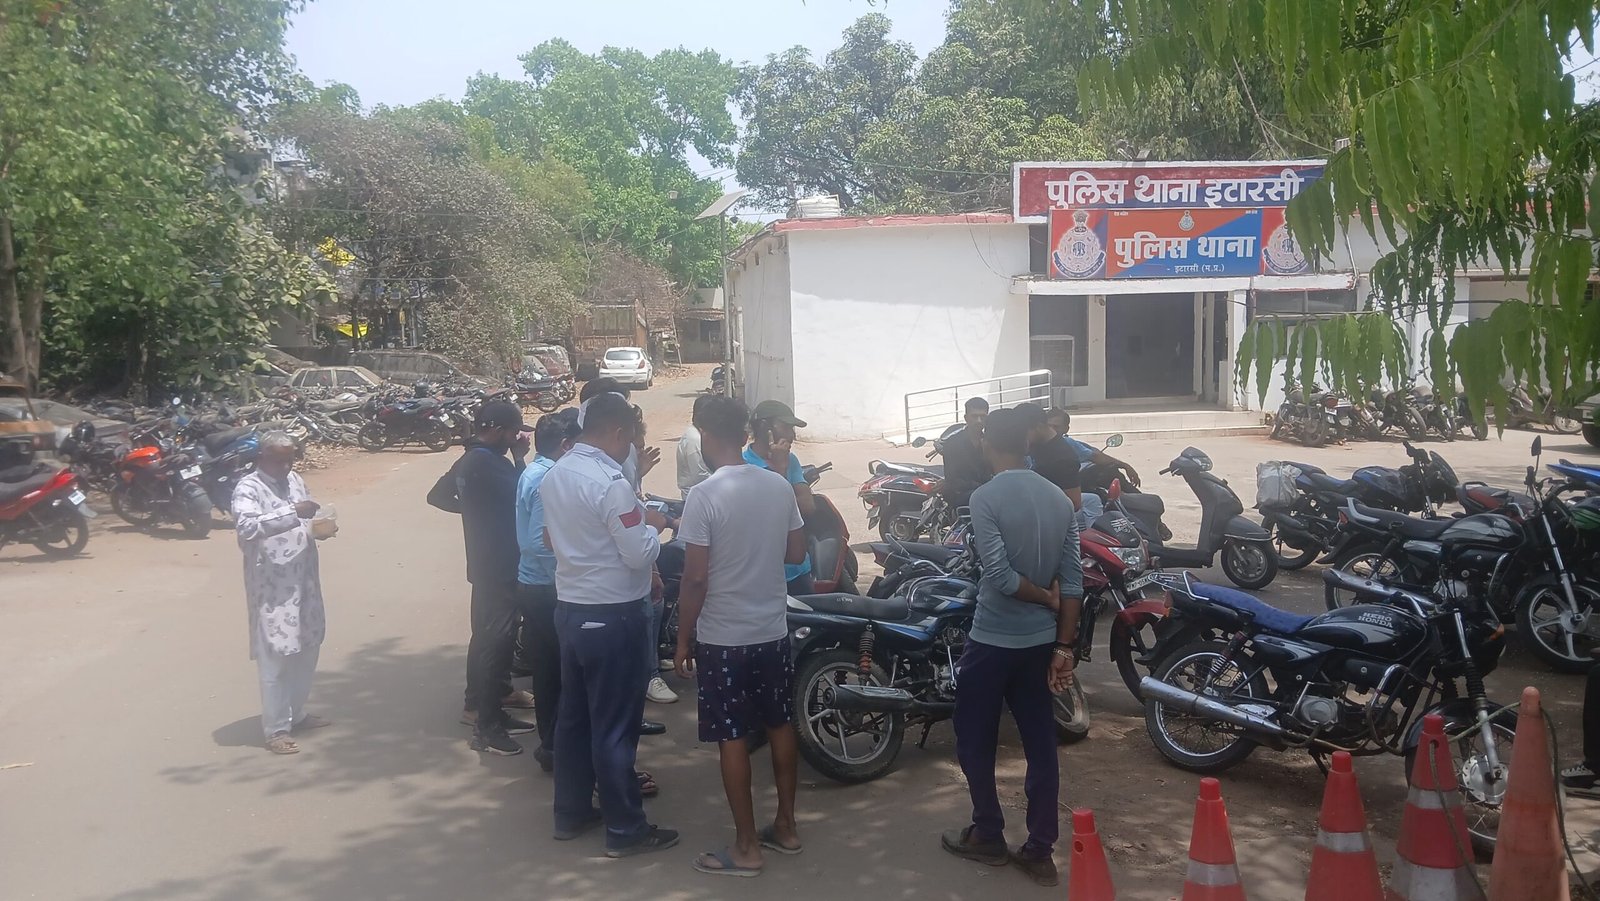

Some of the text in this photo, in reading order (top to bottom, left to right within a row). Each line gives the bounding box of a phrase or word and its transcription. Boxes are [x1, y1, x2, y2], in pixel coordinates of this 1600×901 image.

[1045, 168, 1304, 209] पुलिस थाना इटारसी
[1114, 231, 1256, 268] पुलिस थाना
[1174, 263, 1199, 274] इटारसी
[1358, 616, 1393, 628] HONDA
[1363, 612, 1392, 622] HERO
